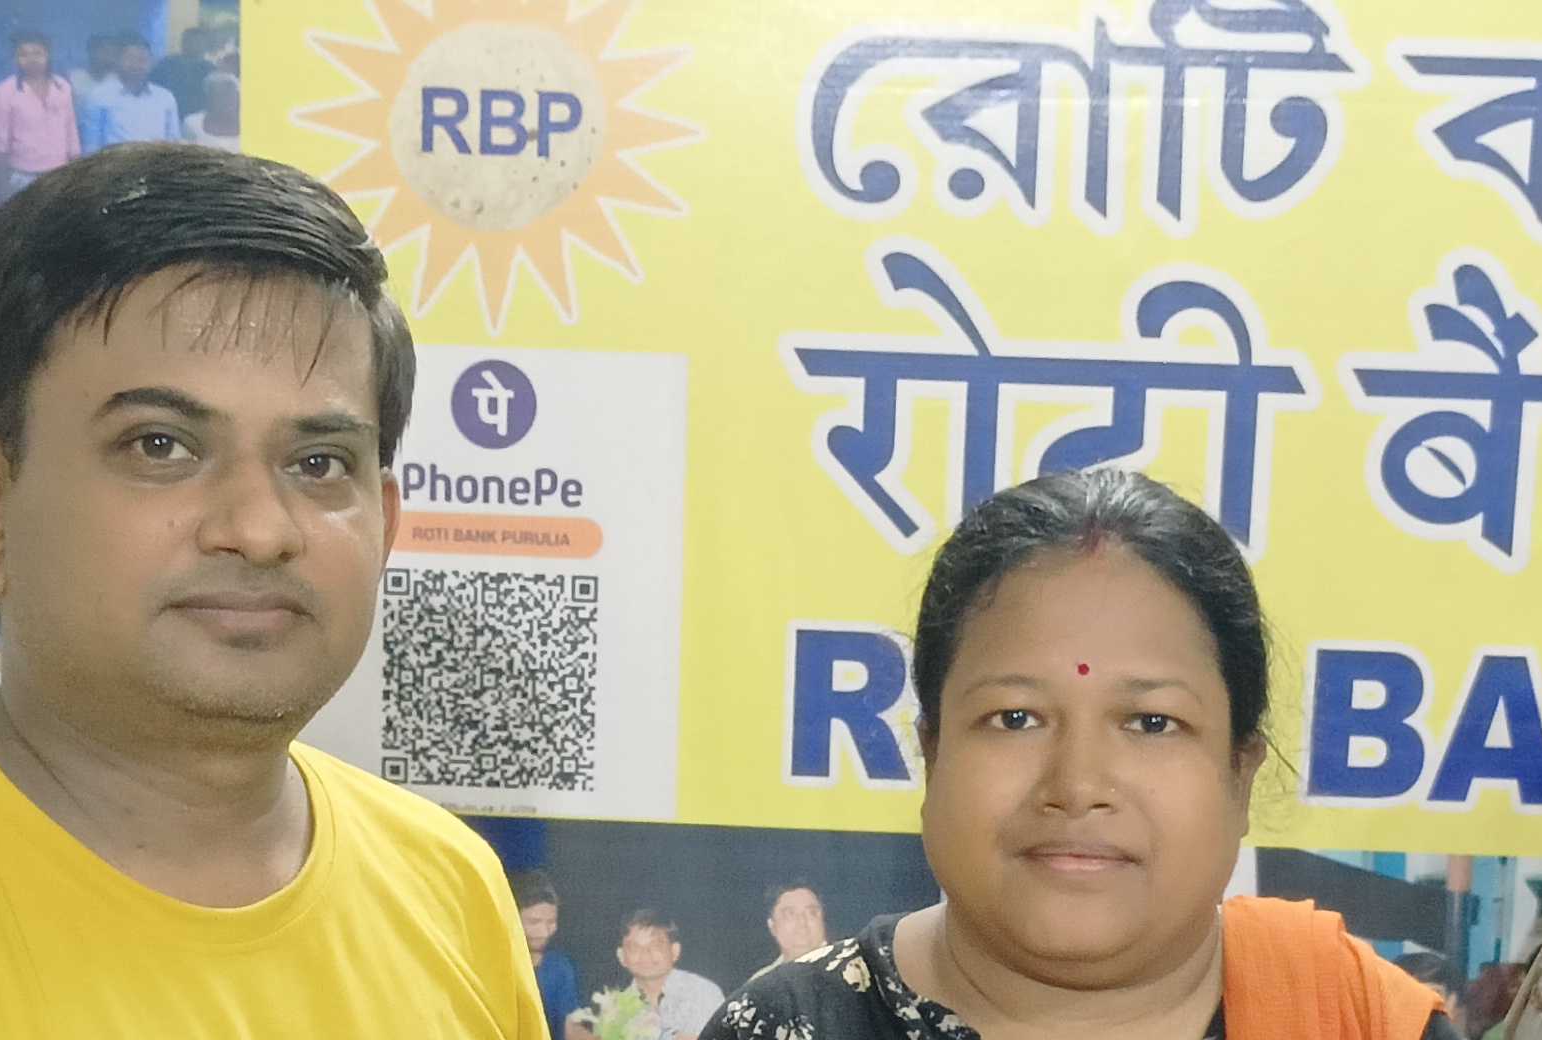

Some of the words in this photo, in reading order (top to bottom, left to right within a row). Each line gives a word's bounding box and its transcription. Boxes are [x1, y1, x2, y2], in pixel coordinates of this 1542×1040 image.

[420, 86, 583, 158] RBP
[811, 0, 1355, 222] রোটি
[472, 370, 514, 437] पे
[402, 462, 584, 508] PhonePe
[412, 526, 449, 541] ROTI
[453, 528, 496, 544] BANK
[501, 530, 571, 547] PURULIA
